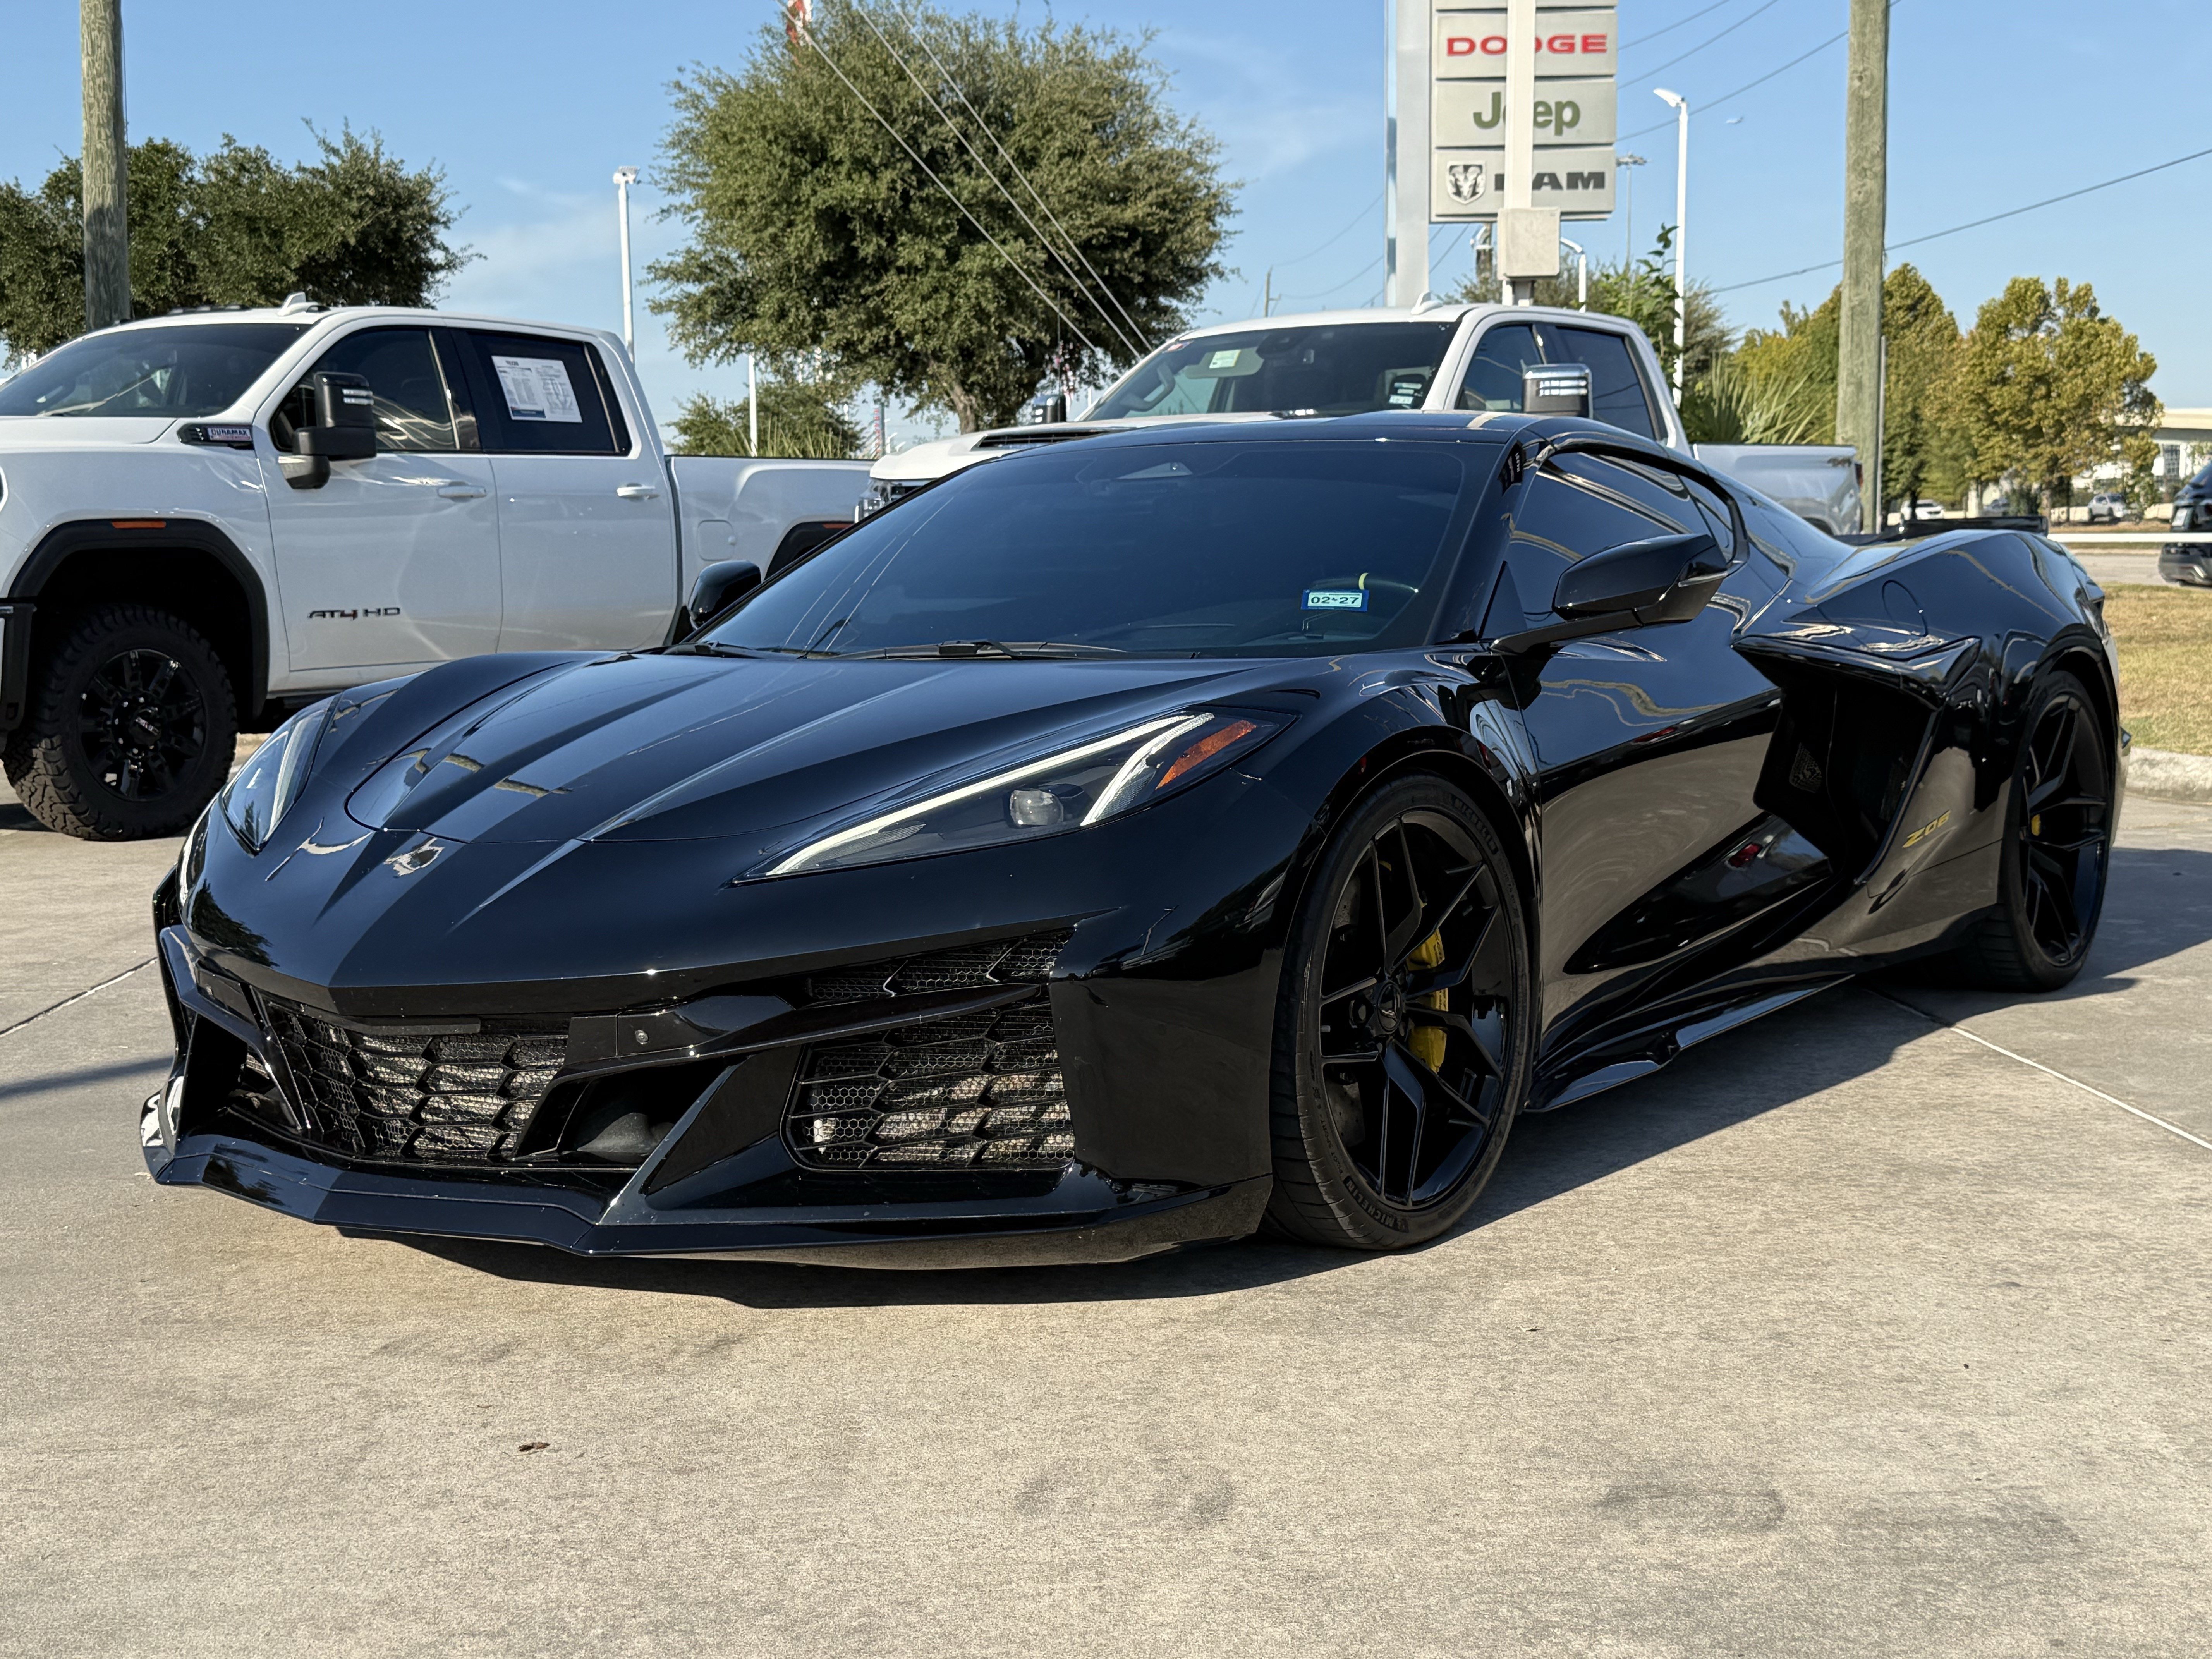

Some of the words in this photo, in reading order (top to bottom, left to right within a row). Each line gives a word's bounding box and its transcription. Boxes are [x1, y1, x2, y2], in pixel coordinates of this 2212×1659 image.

[1447, 34, 1607, 56] DOGE
[1473, 92, 1581, 136] Jep
[307, 609, 357, 620] AT4
[363, 607, 400, 617] HD
[1902, 809, 1952, 848] Z06
[1346, 1180, 1395, 1227] MICHELIN
